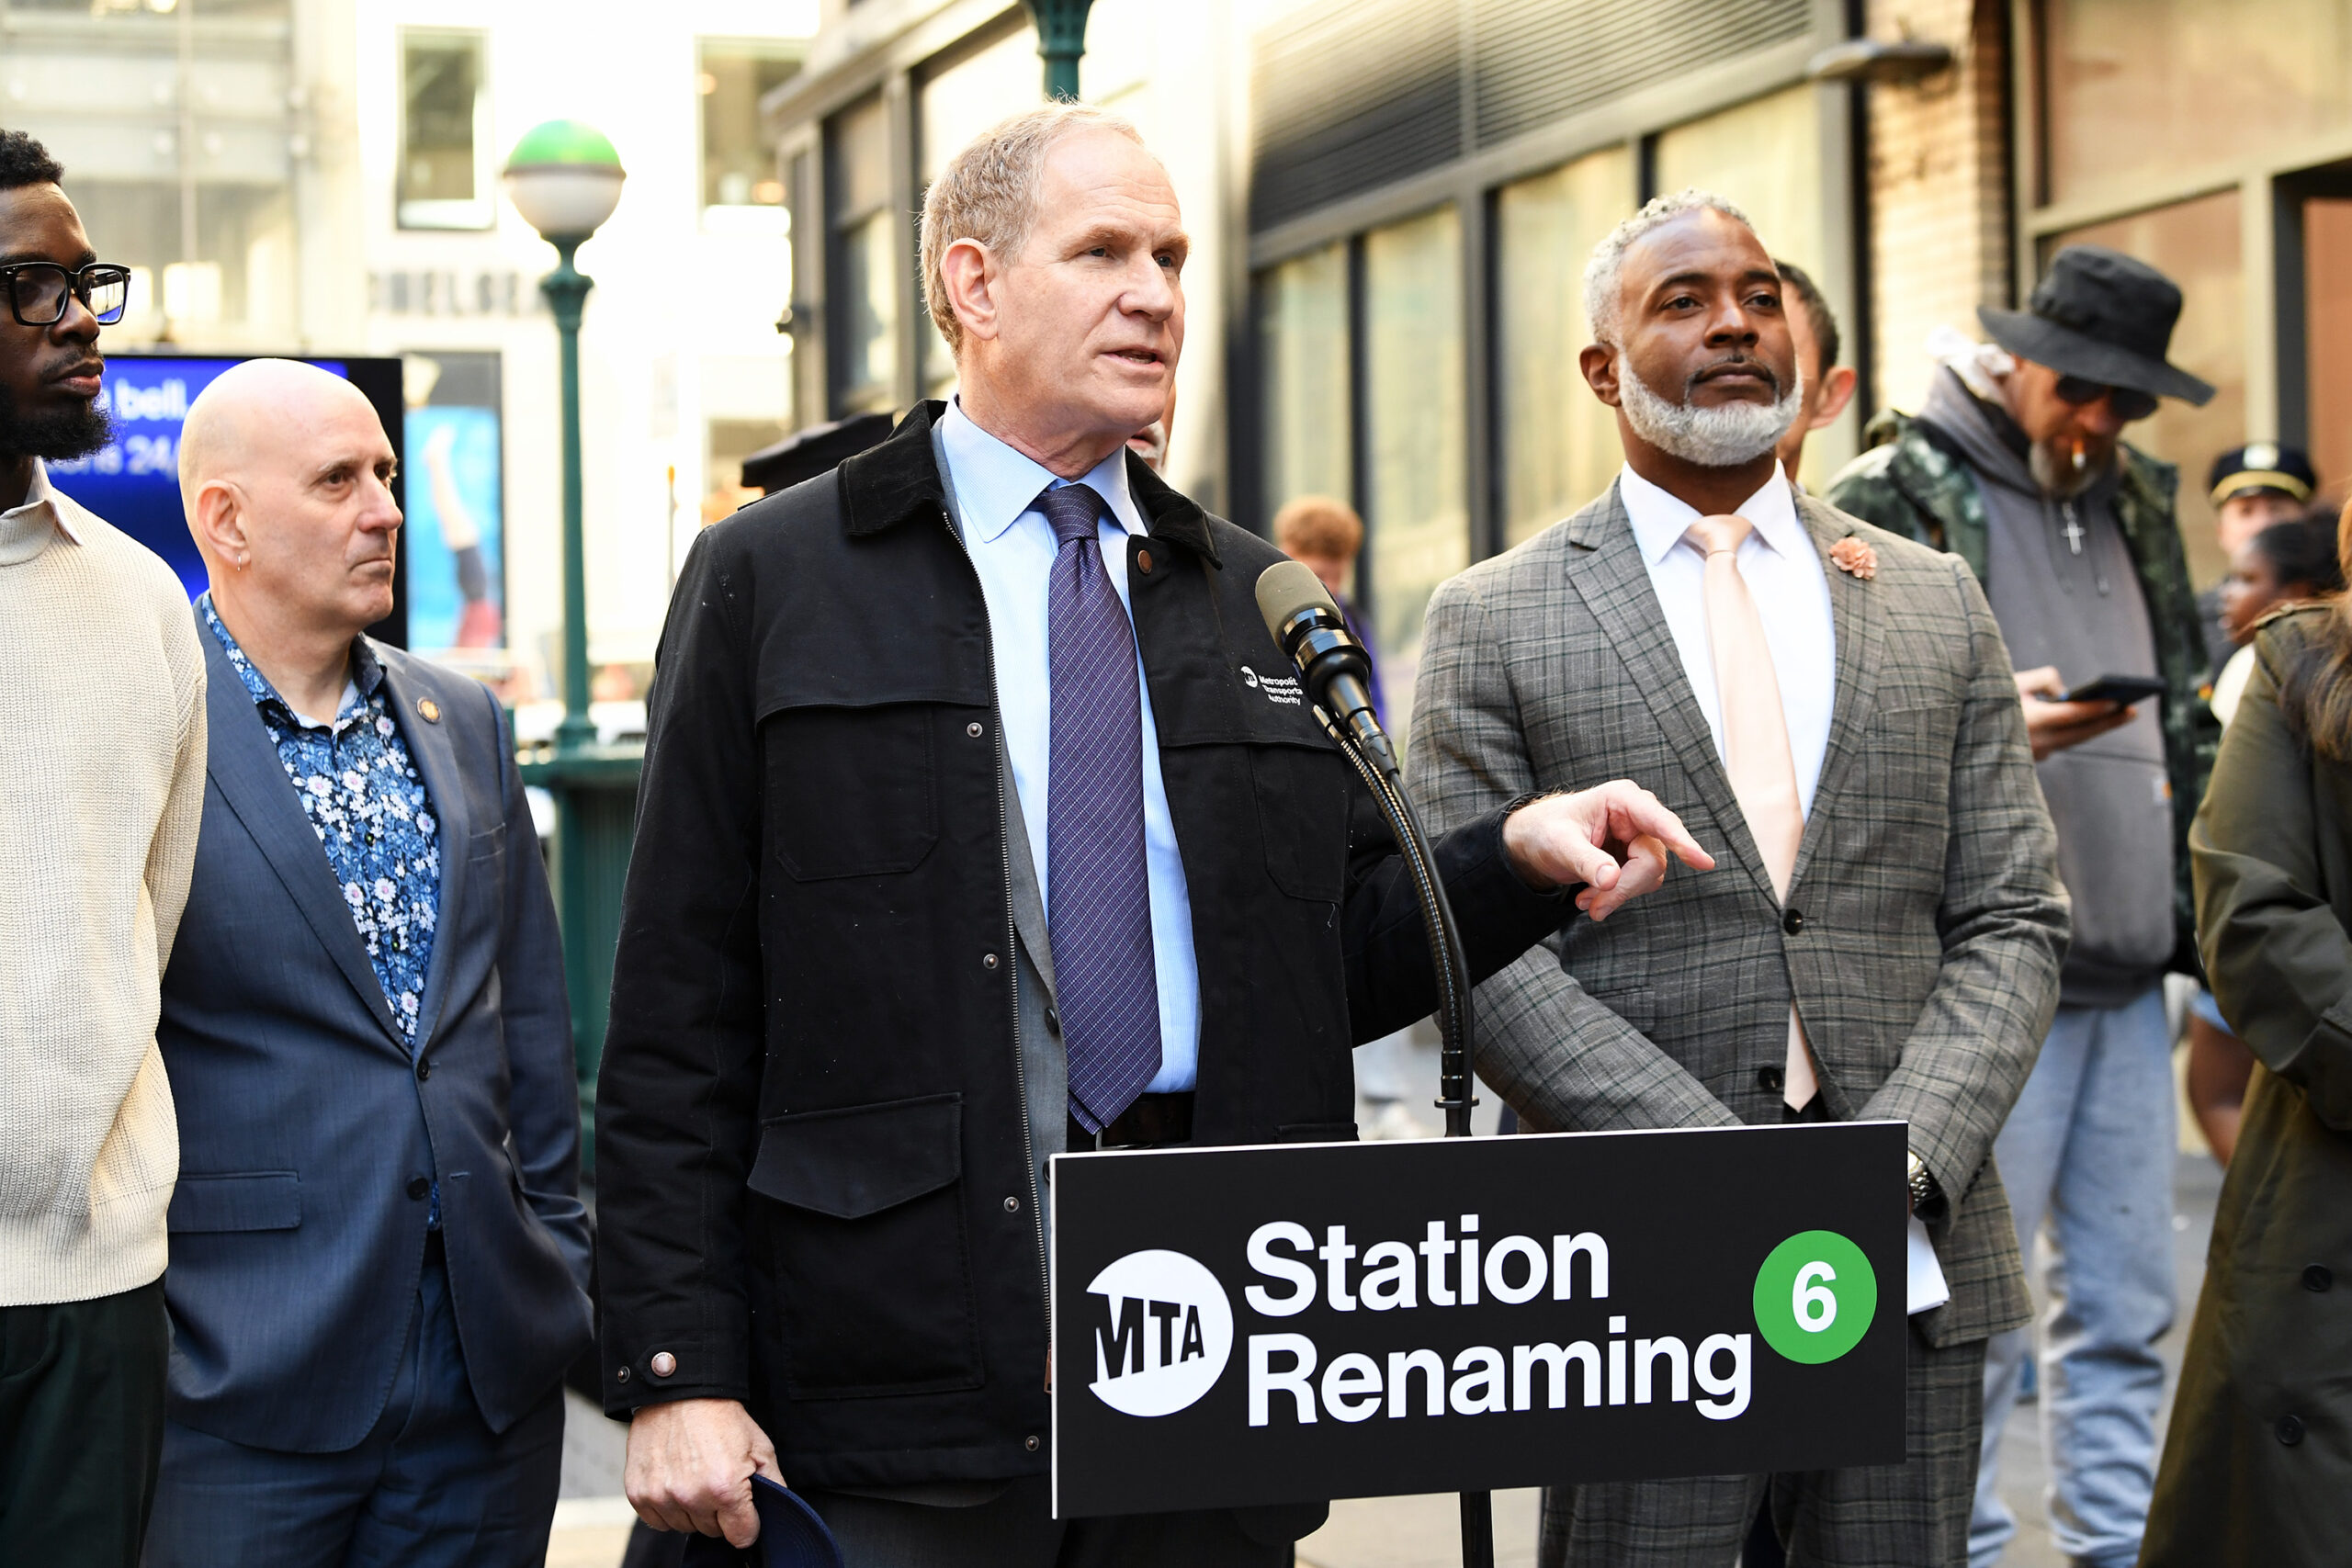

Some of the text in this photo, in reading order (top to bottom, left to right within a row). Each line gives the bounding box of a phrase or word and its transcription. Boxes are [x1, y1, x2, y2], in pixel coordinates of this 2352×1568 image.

[1259, 674, 1298, 687] Metropolit
[1261, 684, 1303, 696] Transporta
[1268, 694, 1301, 705] Authority
[1245, 1213, 1609, 1316] Station
[1792, 1260, 1838, 1333] 6
[1088, 1292, 1204, 1382] MTA
[1249, 1315, 1752, 1427] Renaming
